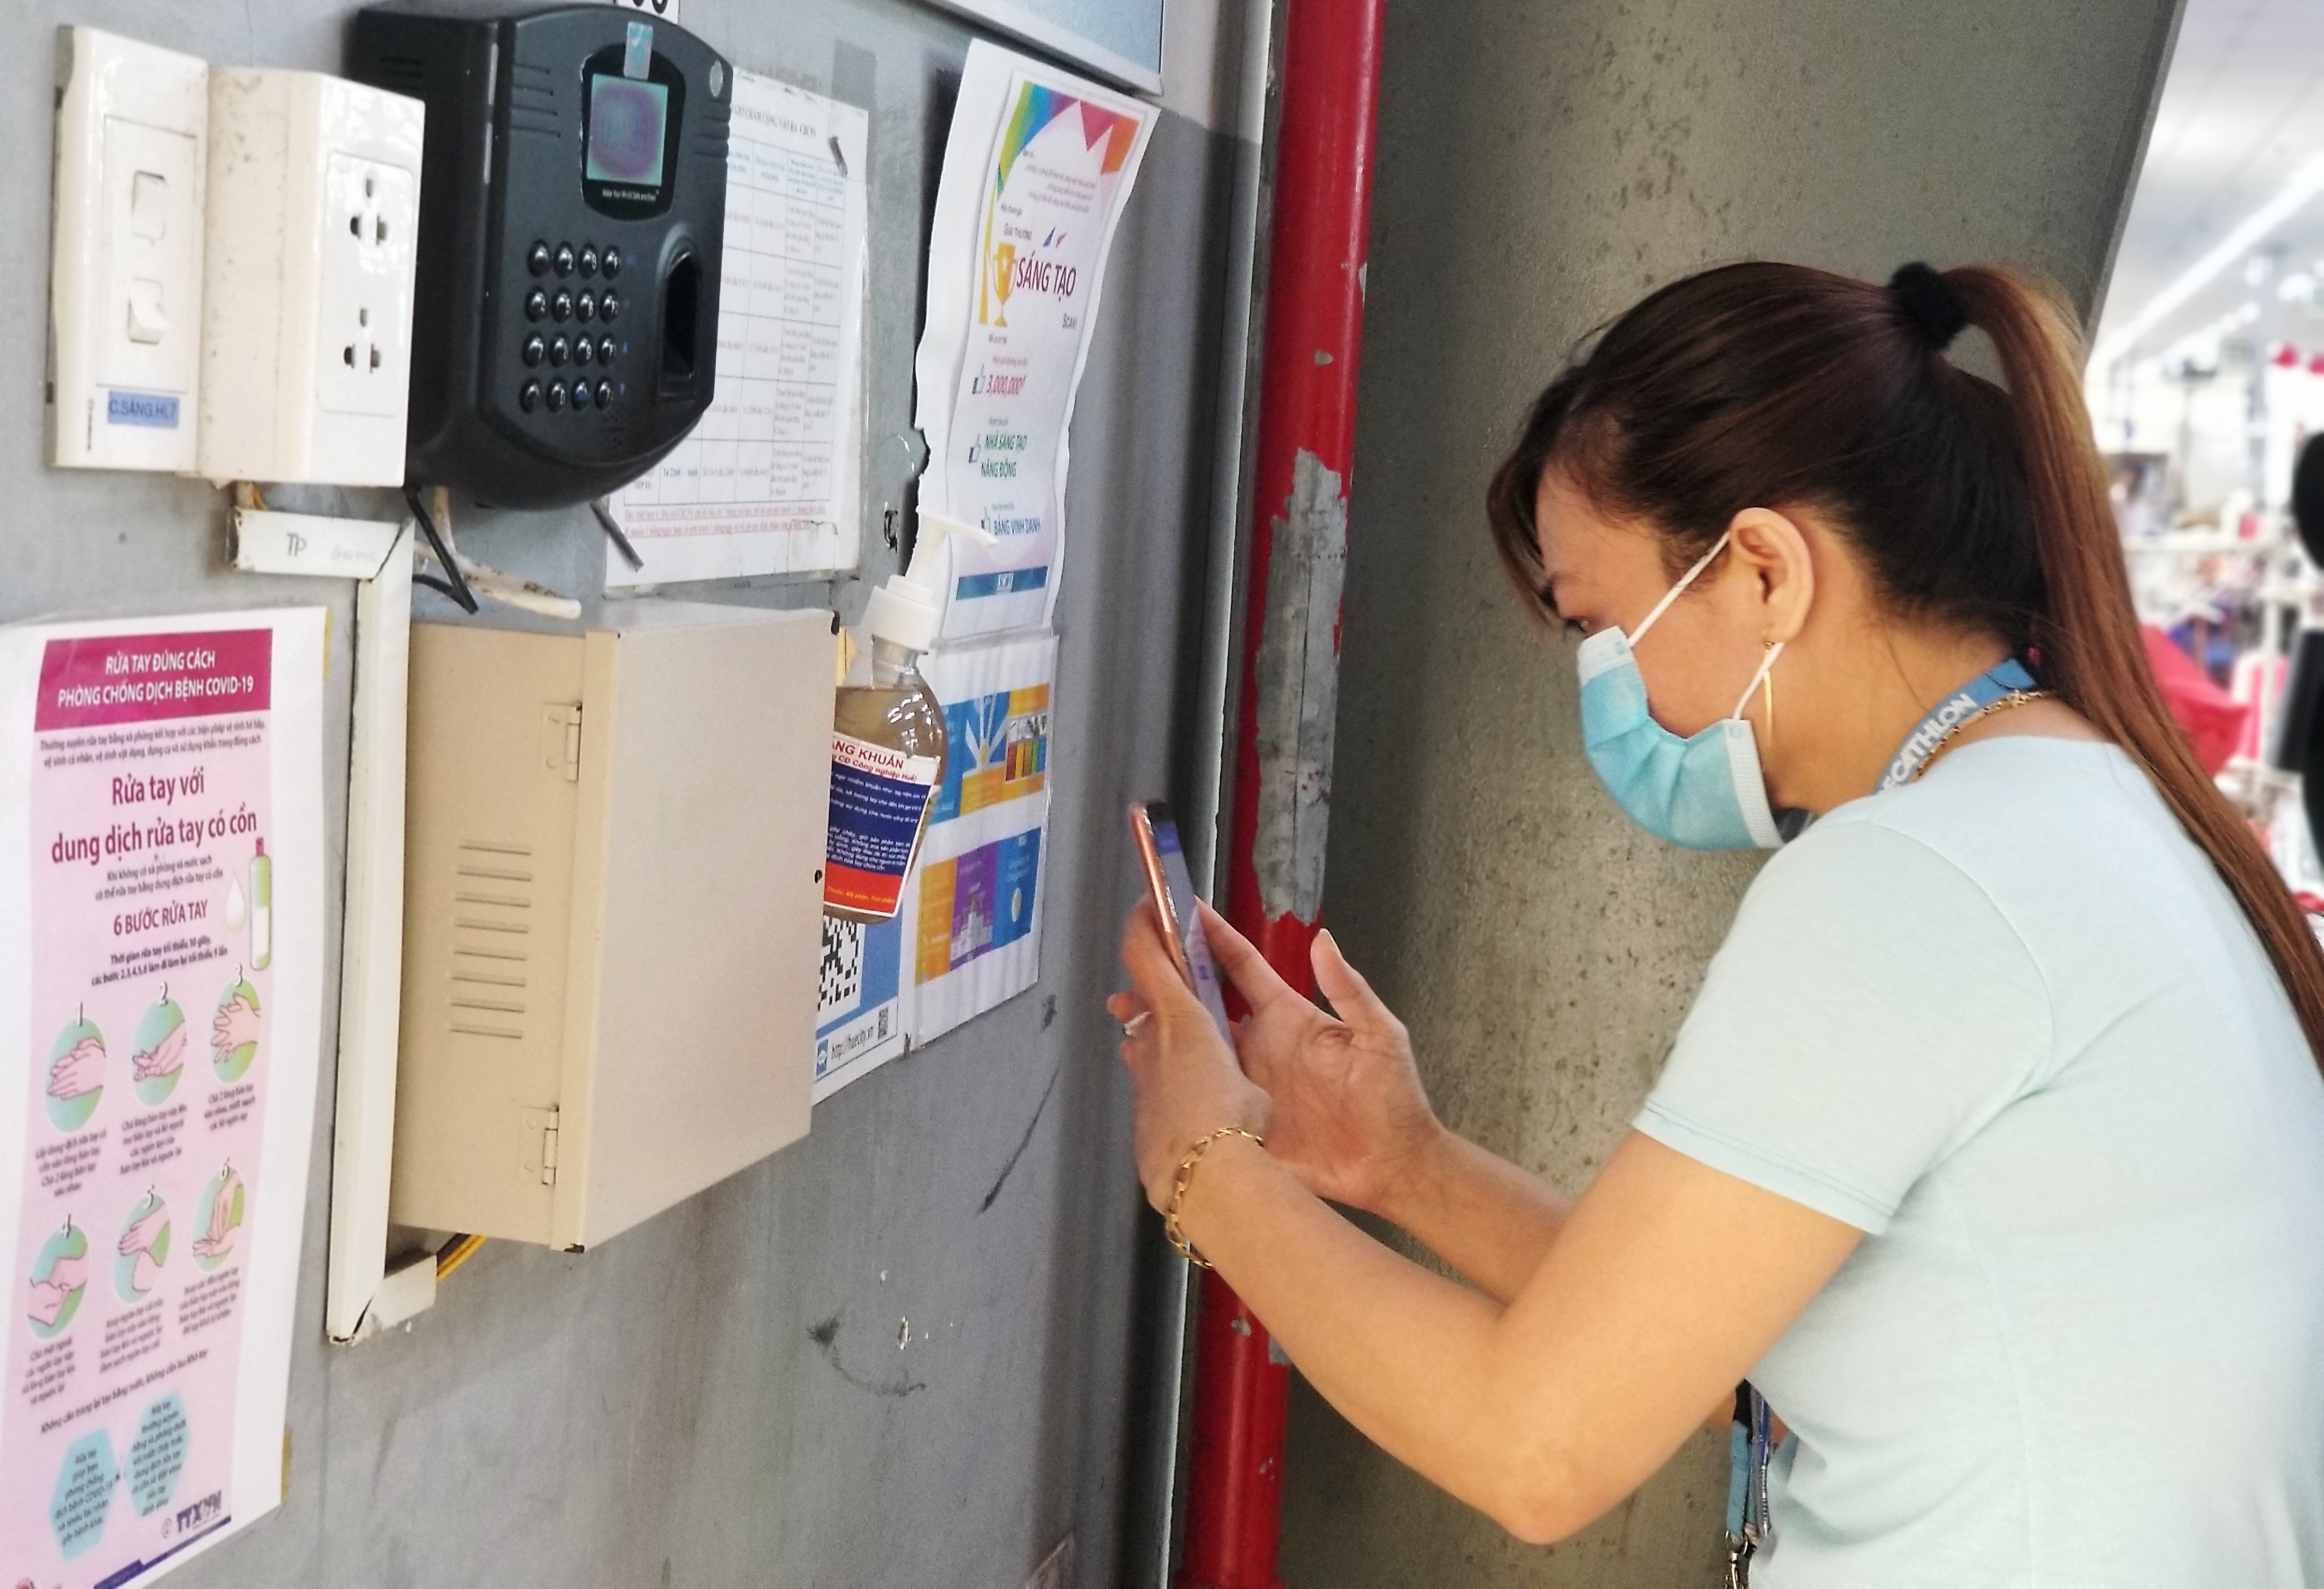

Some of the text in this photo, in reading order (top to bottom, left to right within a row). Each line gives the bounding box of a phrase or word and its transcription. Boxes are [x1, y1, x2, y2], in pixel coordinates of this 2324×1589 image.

[1016, 250, 1077, 302] SÁNG TẠO
[105, 648, 215, 674] RỬA TAY ĐÚNG CÁCH
[58, 675, 254, 708] PHÒNG CHỐNG DỊCH BỆNH COVID-19
[832, 740, 855, 755] NG
[112, 767, 204, 805] Rửa tay với
[51, 802, 256, 865] dung dịch rửa tay có cồn
[114, 900, 208, 935] 6 BƯỚC RỬA TAY
